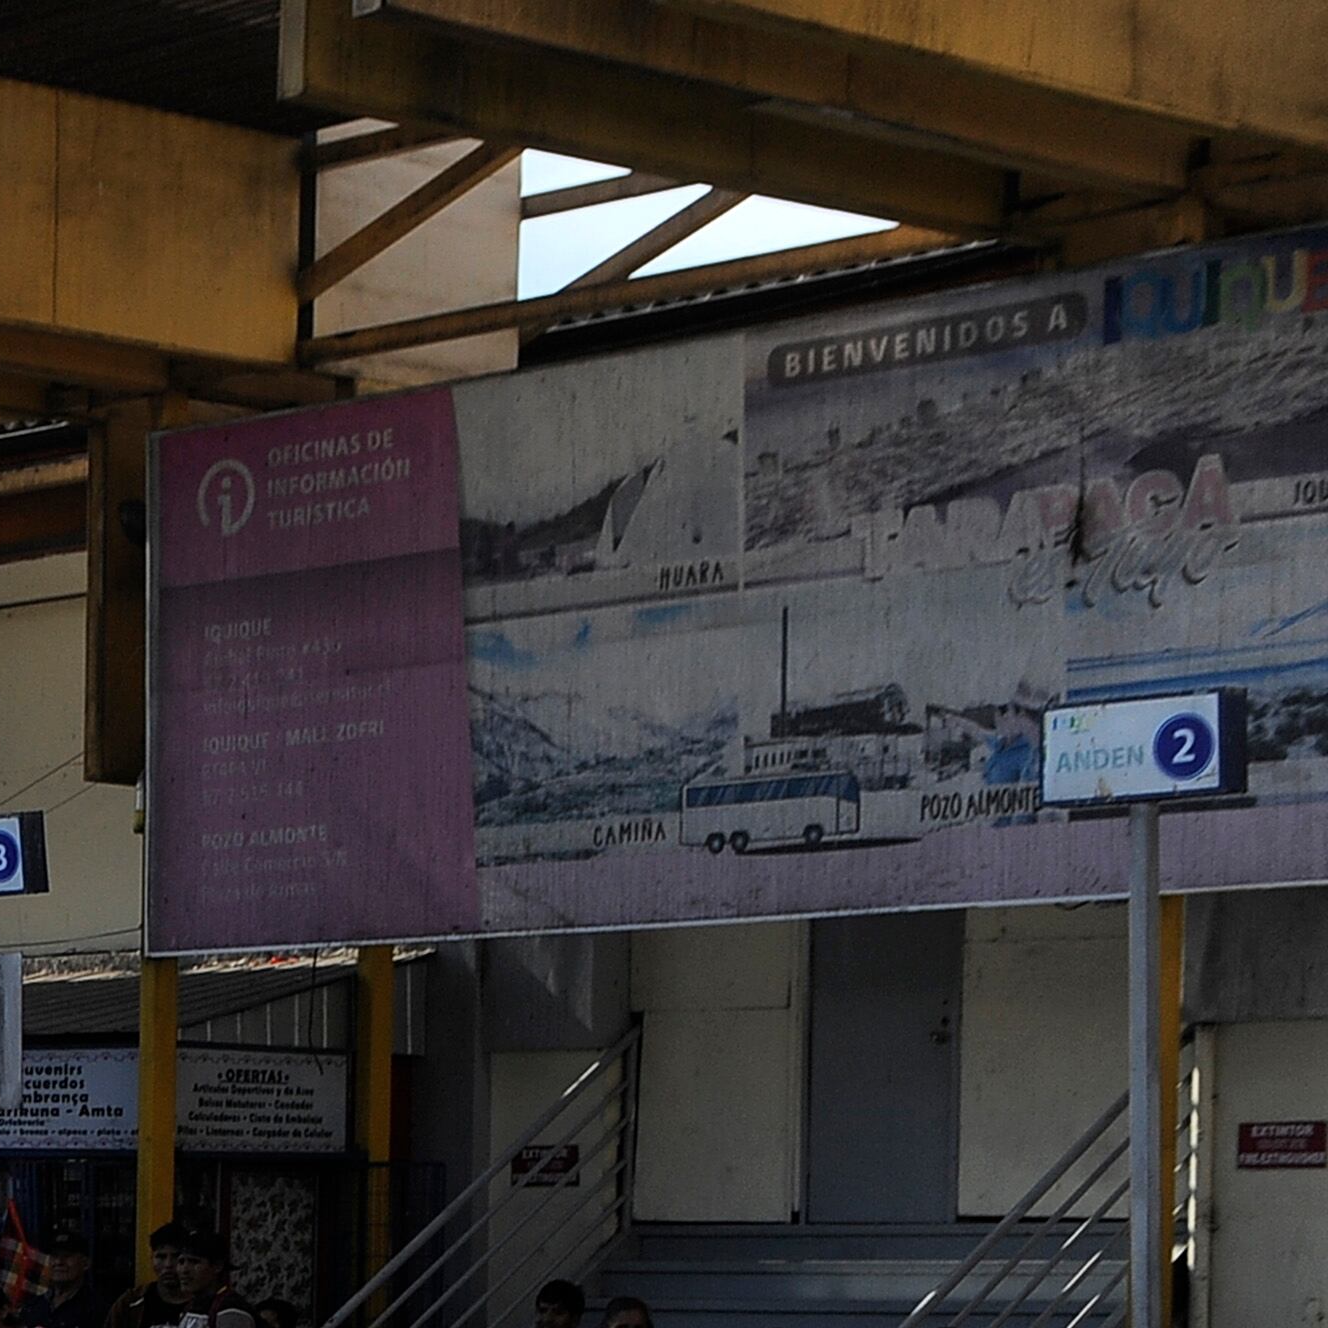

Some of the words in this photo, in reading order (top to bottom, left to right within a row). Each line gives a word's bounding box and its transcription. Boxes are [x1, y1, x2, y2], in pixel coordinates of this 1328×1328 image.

[785, 309, 1030, 378] BIENVENIDOS
[1047, 303, 1068, 331] A
[267, 433, 361, 468] OFICINAS
[368, 427, 394, 450] DE
[267, 456, 411, 498] INFORMACIÓN
[267, 495, 370, 529] TURÍSTICA
[659, 559, 724, 590] HUARA
[204, 617, 272, 644] IQUIQUE
[202, 731, 271, 755] IQUIQUE
[285, 725, 327, 747] MALL
[336, 719, 385, 742] ZOFRI
[1055, 744, 1145, 774] ANDEN
[1171, 728, 1196, 765] 2
[920, 792, 963, 823] POZO
[964, 786, 1043, 818] ALMONTE
[593, 817, 666, 847] CAMIÑA
[24, 1062, 83, 1076] uvenirs
[24, 1076, 85, 1090] cuerdos
[224, 1067, 284, 1084] OFERTAS
[79, 1104, 124, 1118] Amta
